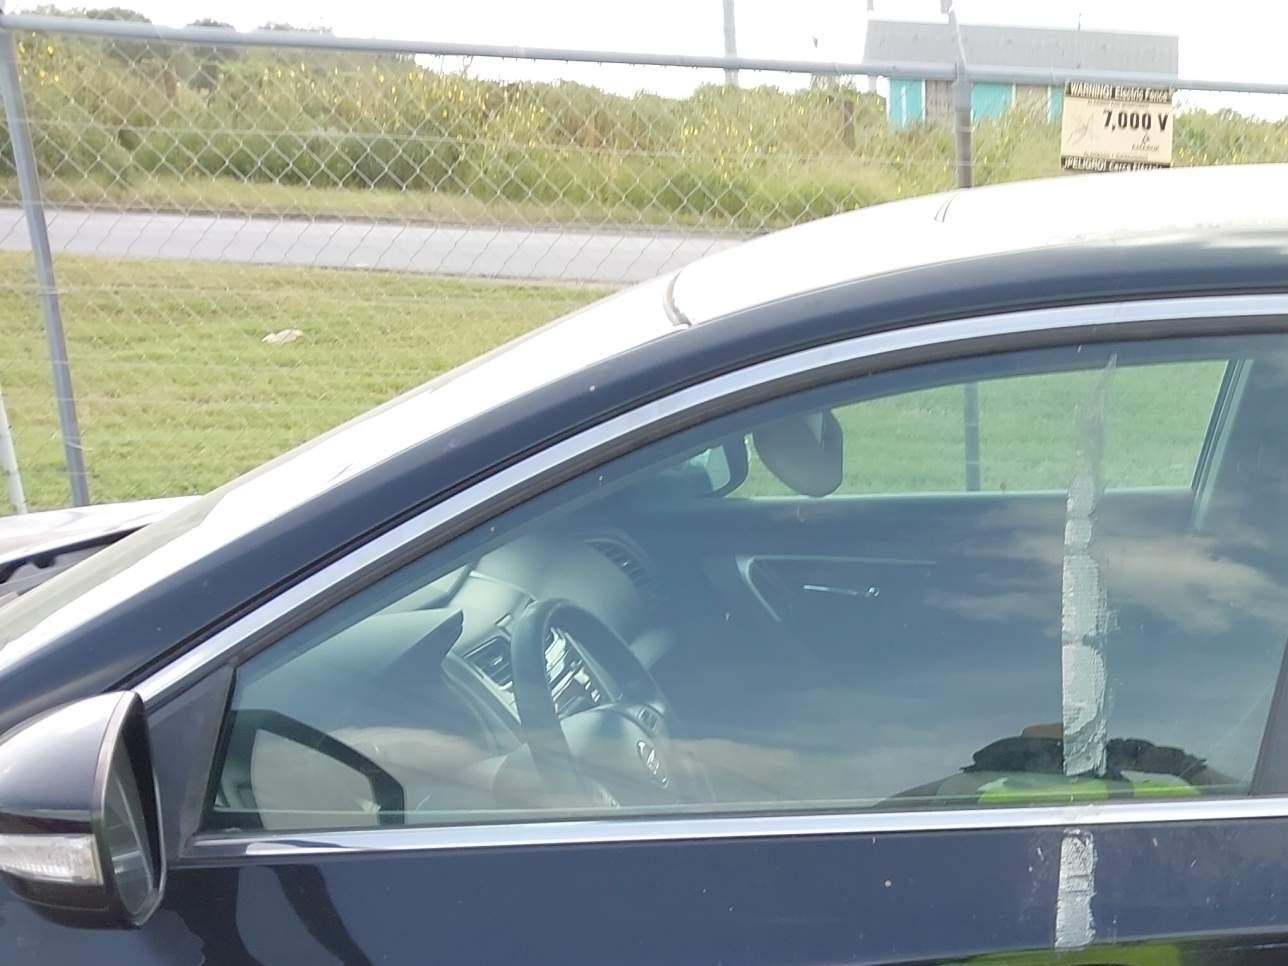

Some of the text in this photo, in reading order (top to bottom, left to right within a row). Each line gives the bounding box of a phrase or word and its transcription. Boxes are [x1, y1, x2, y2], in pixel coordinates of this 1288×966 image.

[1070, 82, 1112, 99] WARNING!
[1145, 88, 1168, 103] Fence
[1104, 110, 1168, 132] 7,000 V
